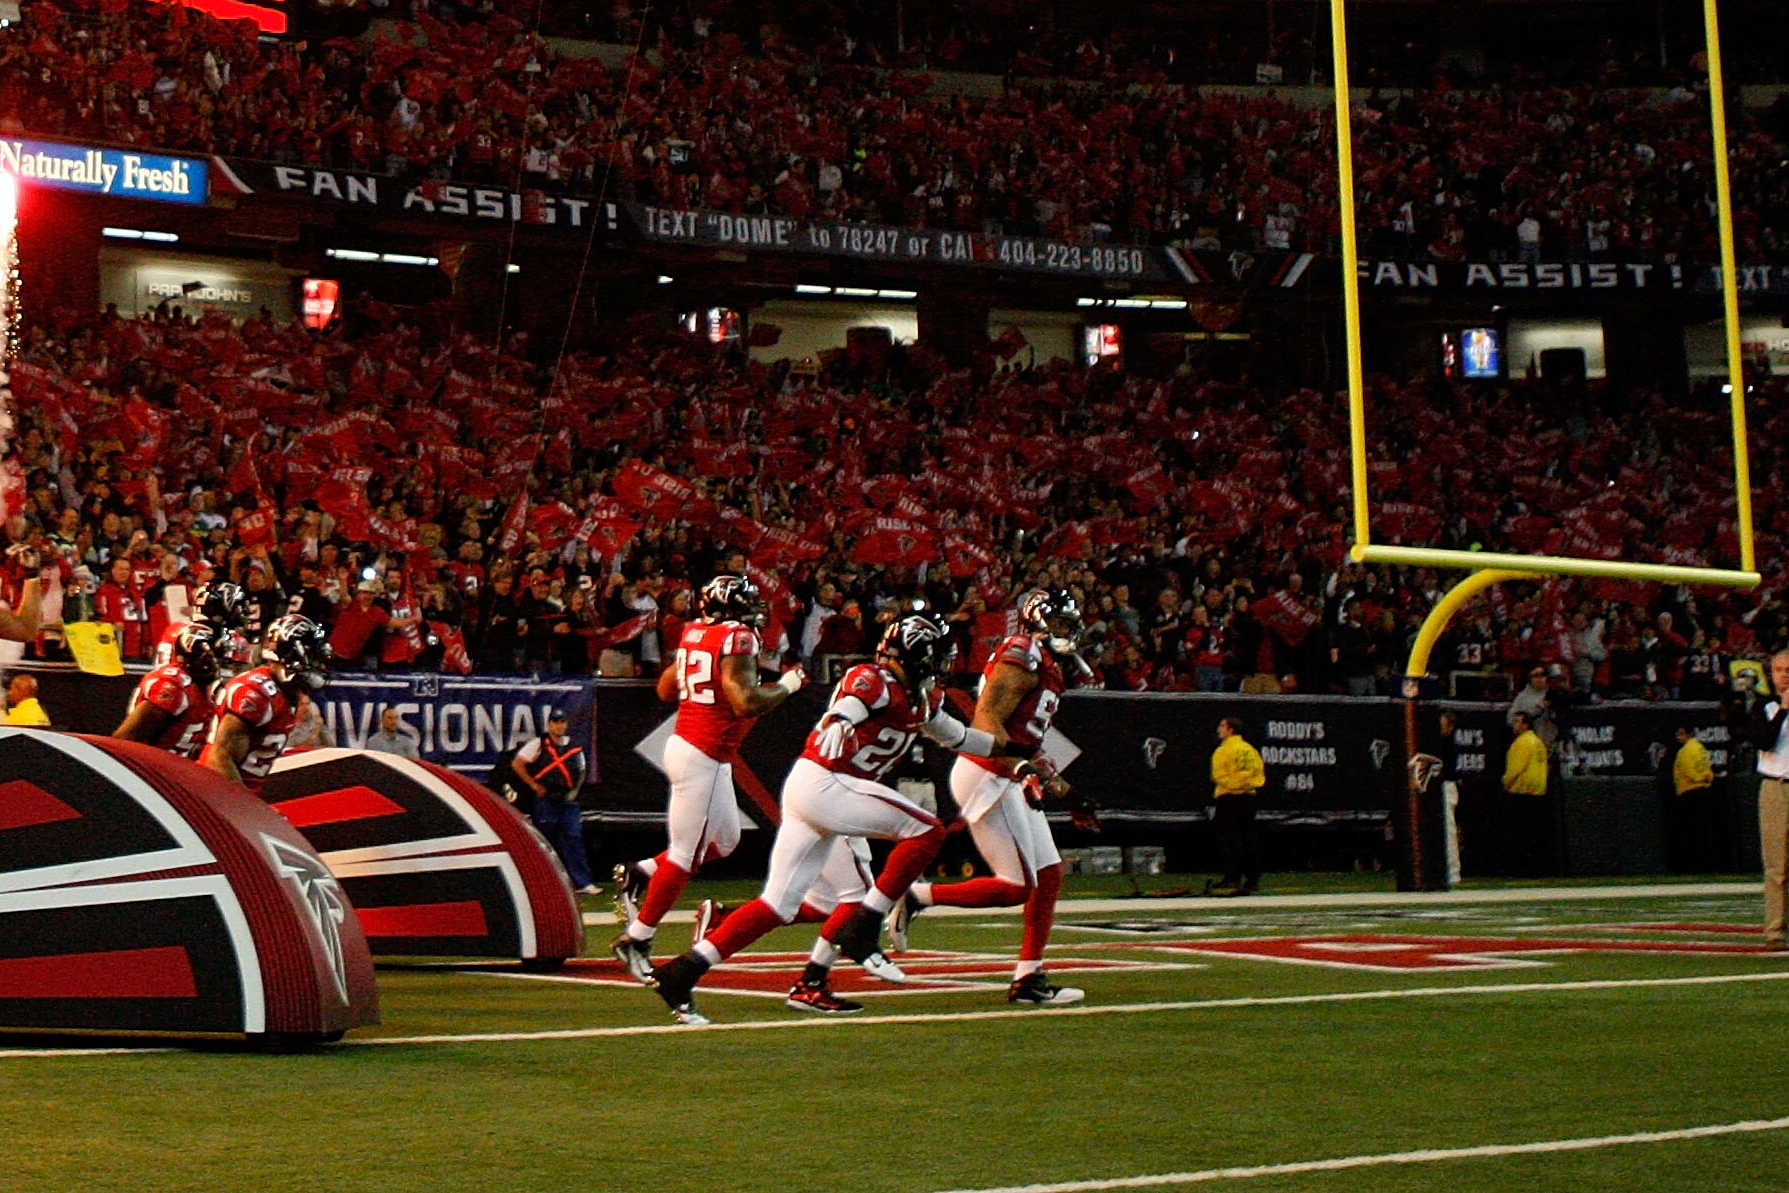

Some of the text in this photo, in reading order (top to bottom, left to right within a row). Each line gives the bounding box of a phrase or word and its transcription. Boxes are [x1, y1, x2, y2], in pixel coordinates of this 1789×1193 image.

[122, 155, 189, 194] Fresh
[275, 166, 378, 205] FAN
[645, 208, 699, 238] TEXT
[811, 224, 830, 248] to
[838, 227, 899, 254] 78247
[908, 237, 929, 257] or
[1000, 239, 1143, 274] 404-223-8850
[1711, 265, 1773, 292] TXT
[1268, 719, 1325, 739] RODDY'S
[1261, 746, 1337, 766] ROCKSTARS
